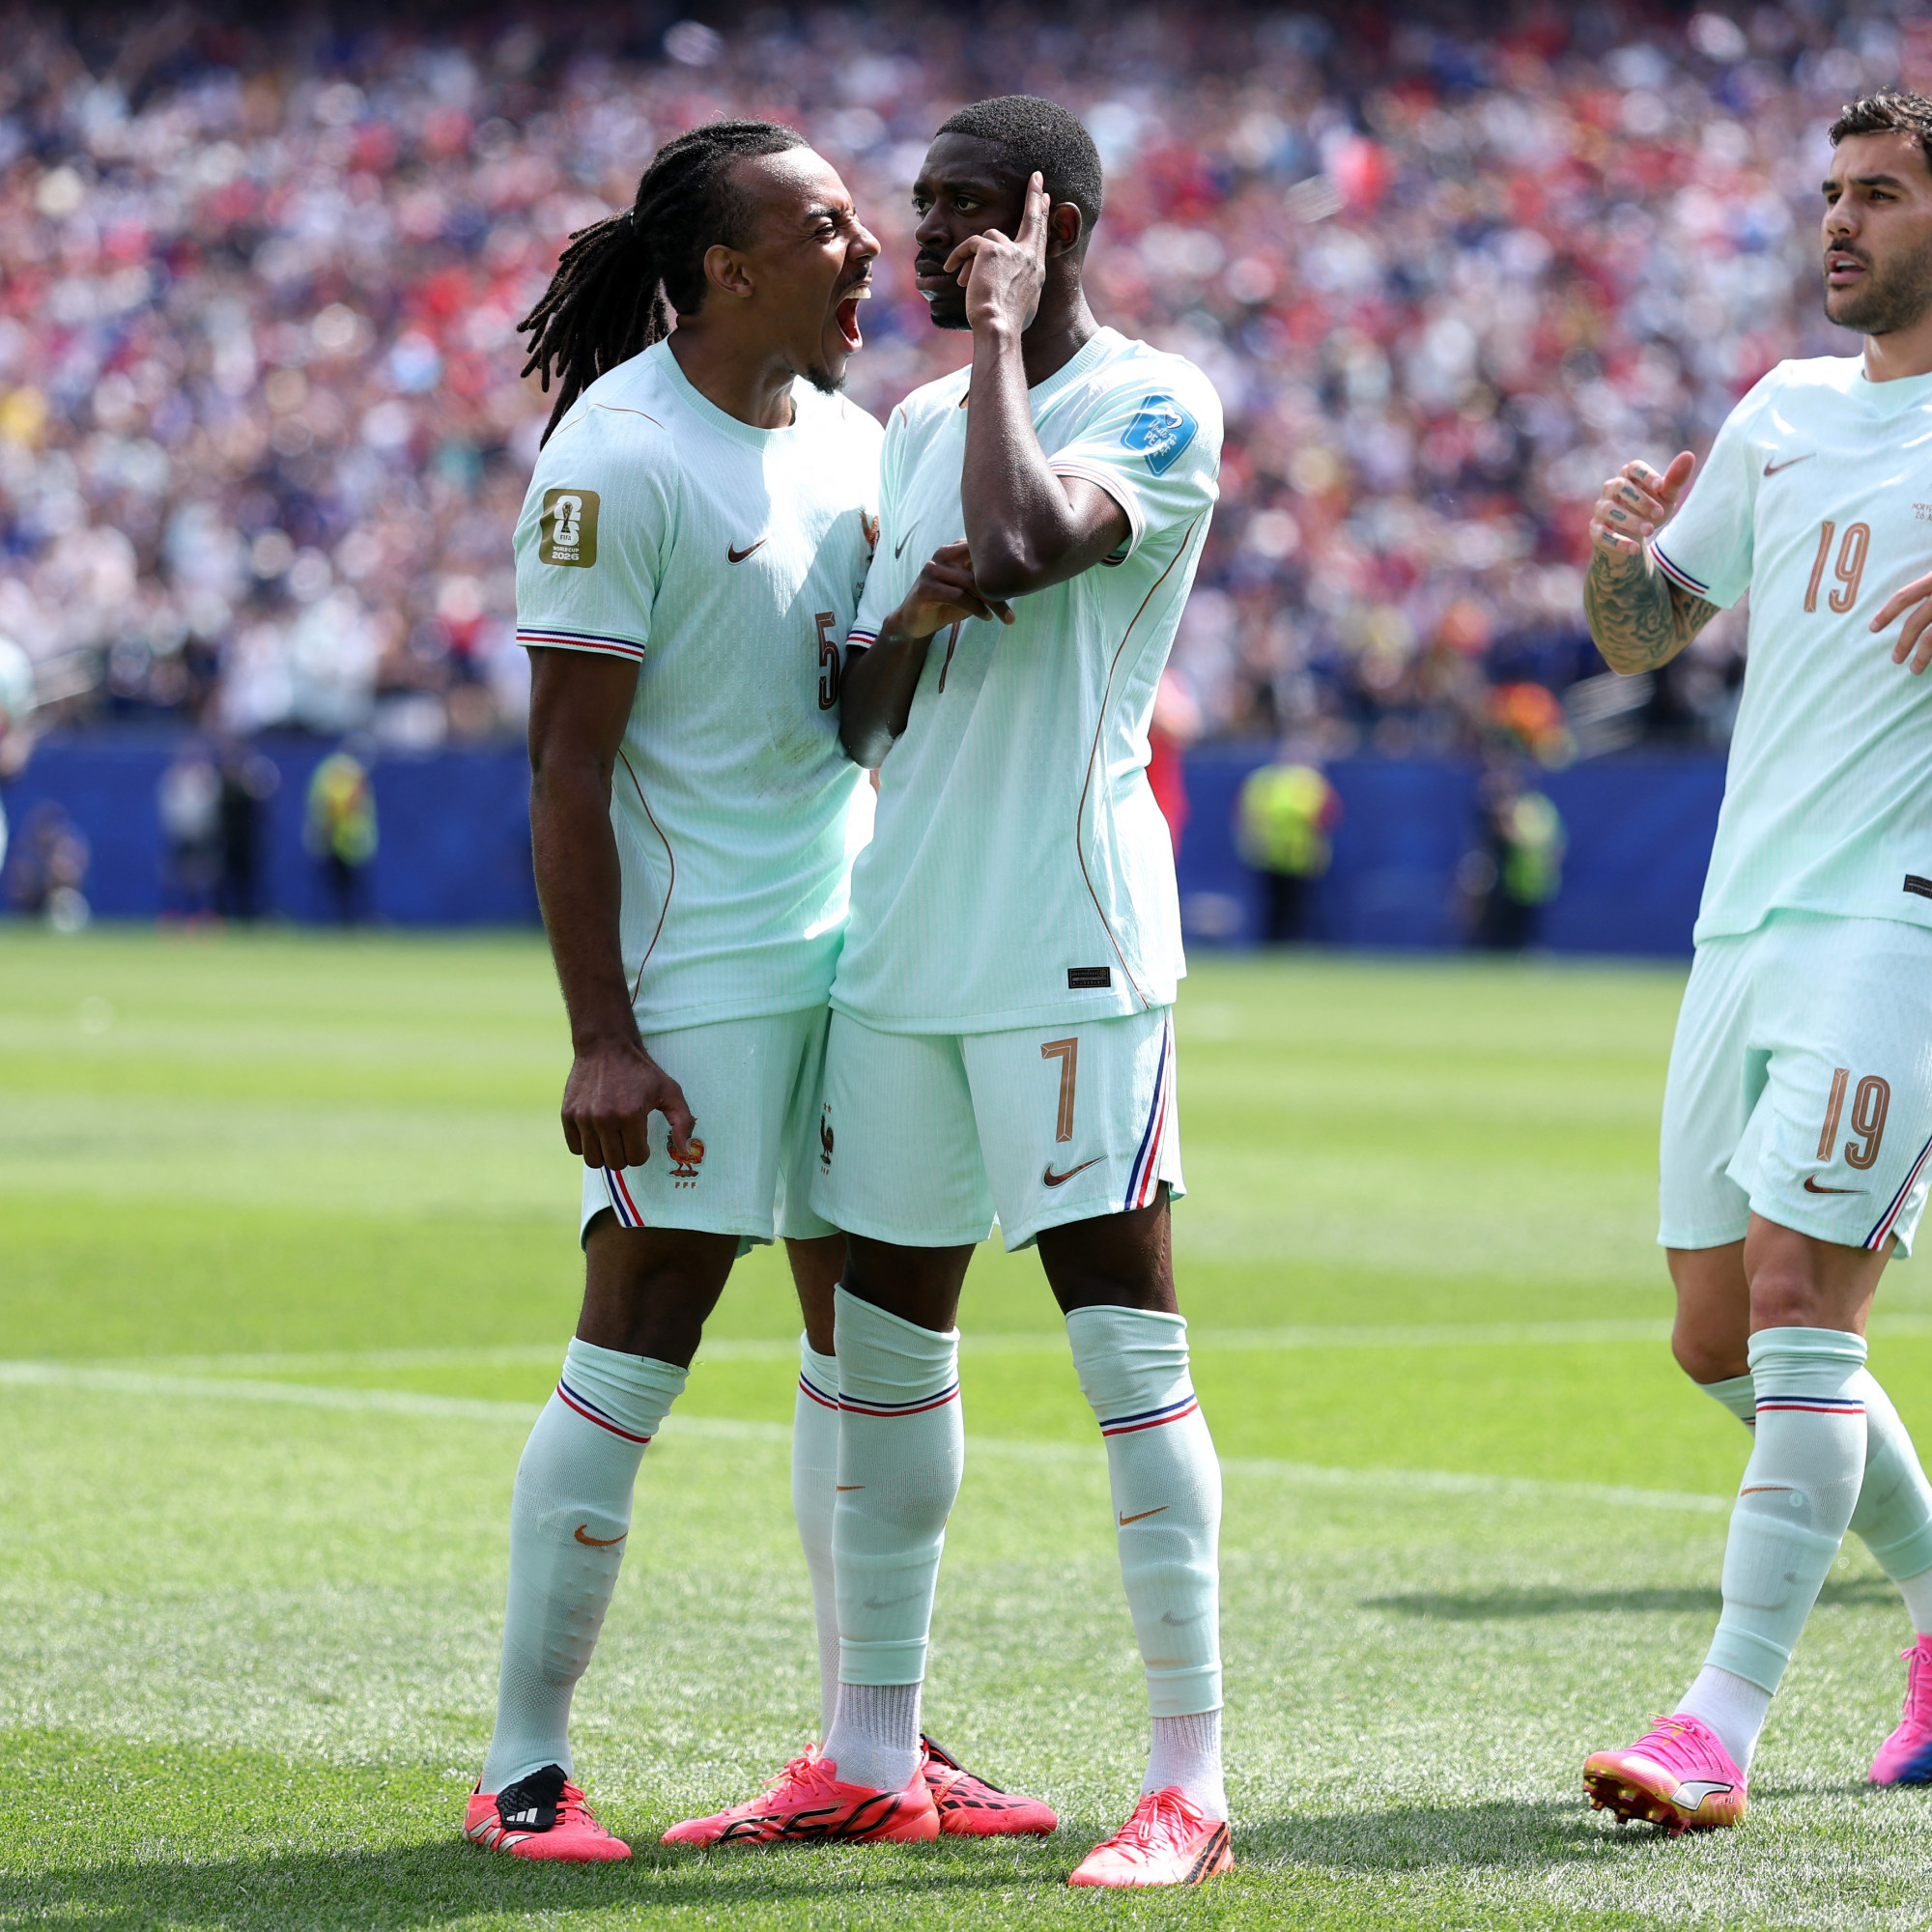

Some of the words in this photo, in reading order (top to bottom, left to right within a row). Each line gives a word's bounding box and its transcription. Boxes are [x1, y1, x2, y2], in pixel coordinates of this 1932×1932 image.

[552, 551, 580, 560] 2026
[1804, 520, 1870, 613] 19
[815, 611, 840, 710] 5
[1040, 1037, 1078, 1143] 7
[1816, 1067, 1890, 1171] 19
